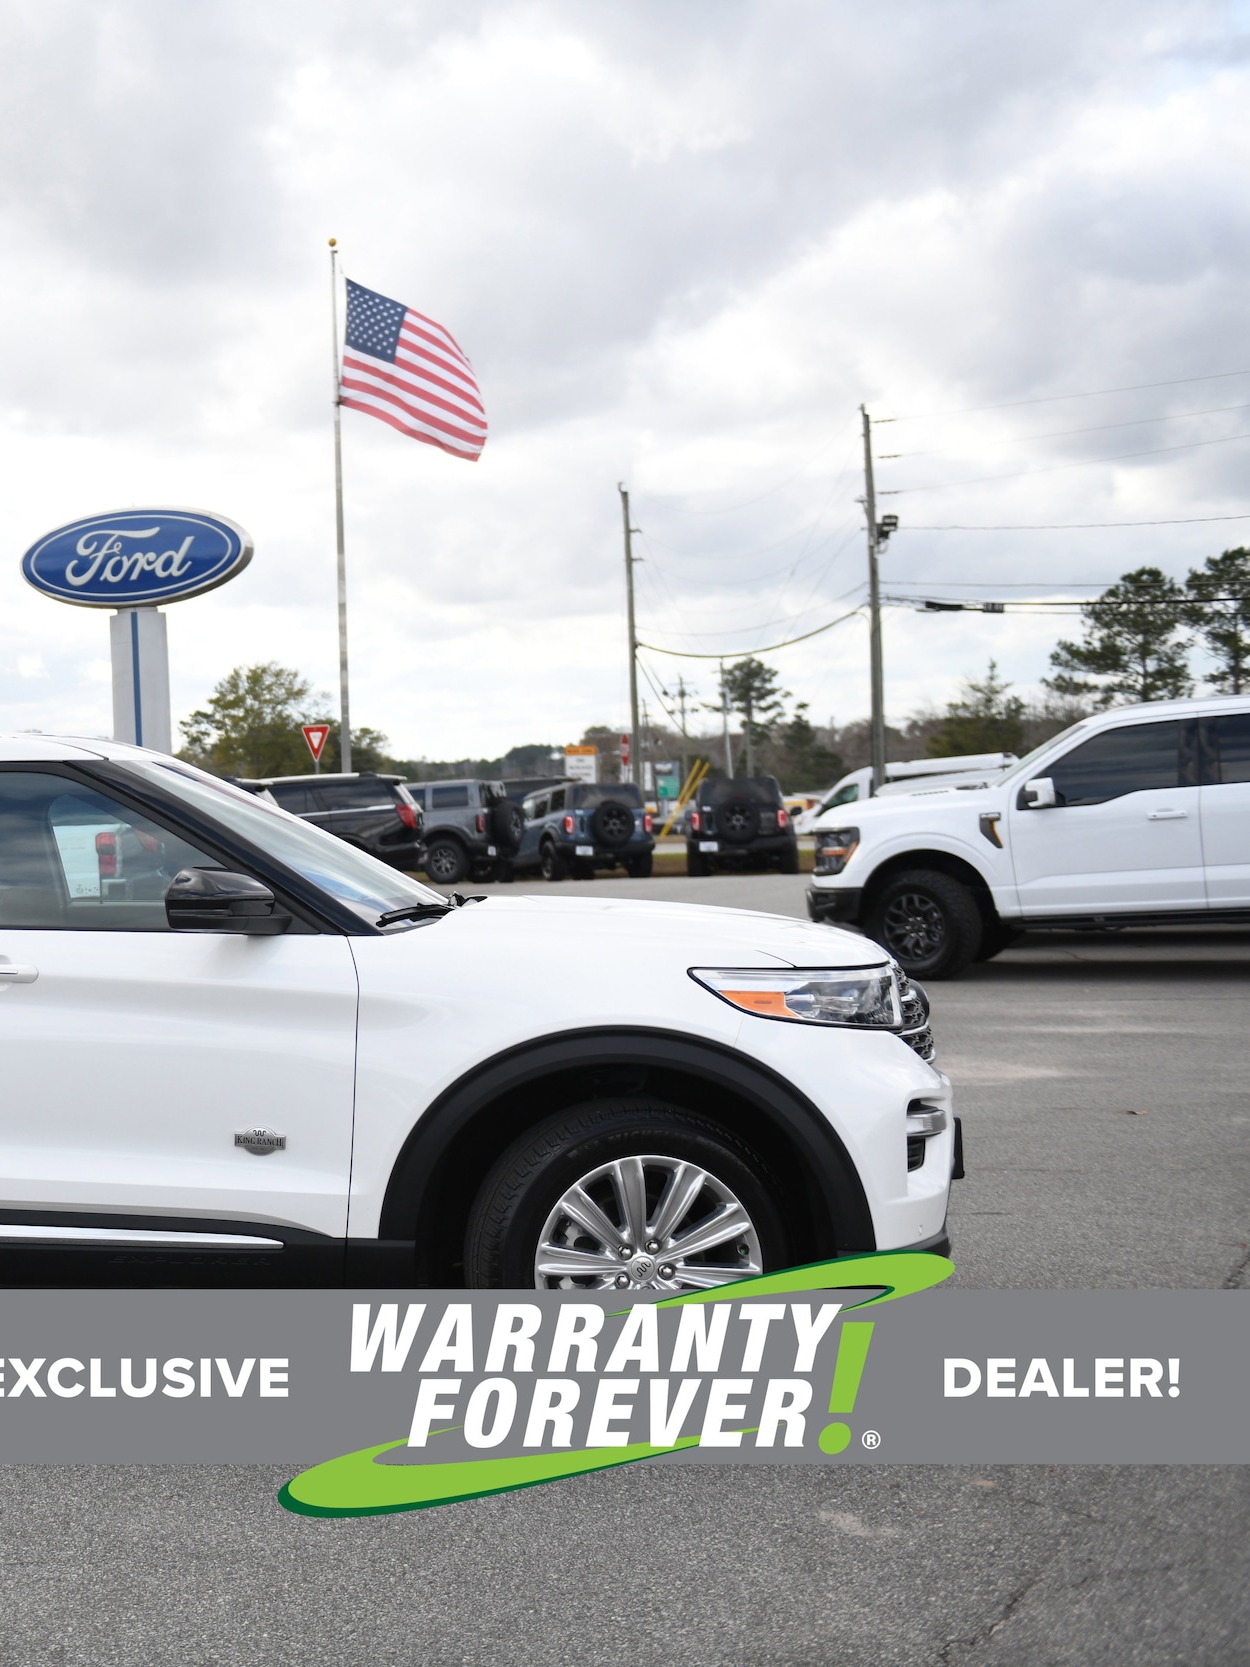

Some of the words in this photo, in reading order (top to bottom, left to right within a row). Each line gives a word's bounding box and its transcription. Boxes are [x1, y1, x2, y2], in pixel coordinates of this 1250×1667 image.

[66, 526, 195, 586] Ford
[237, 1135, 255, 1145] KING
[256, 1137, 282, 1147] RANCH
